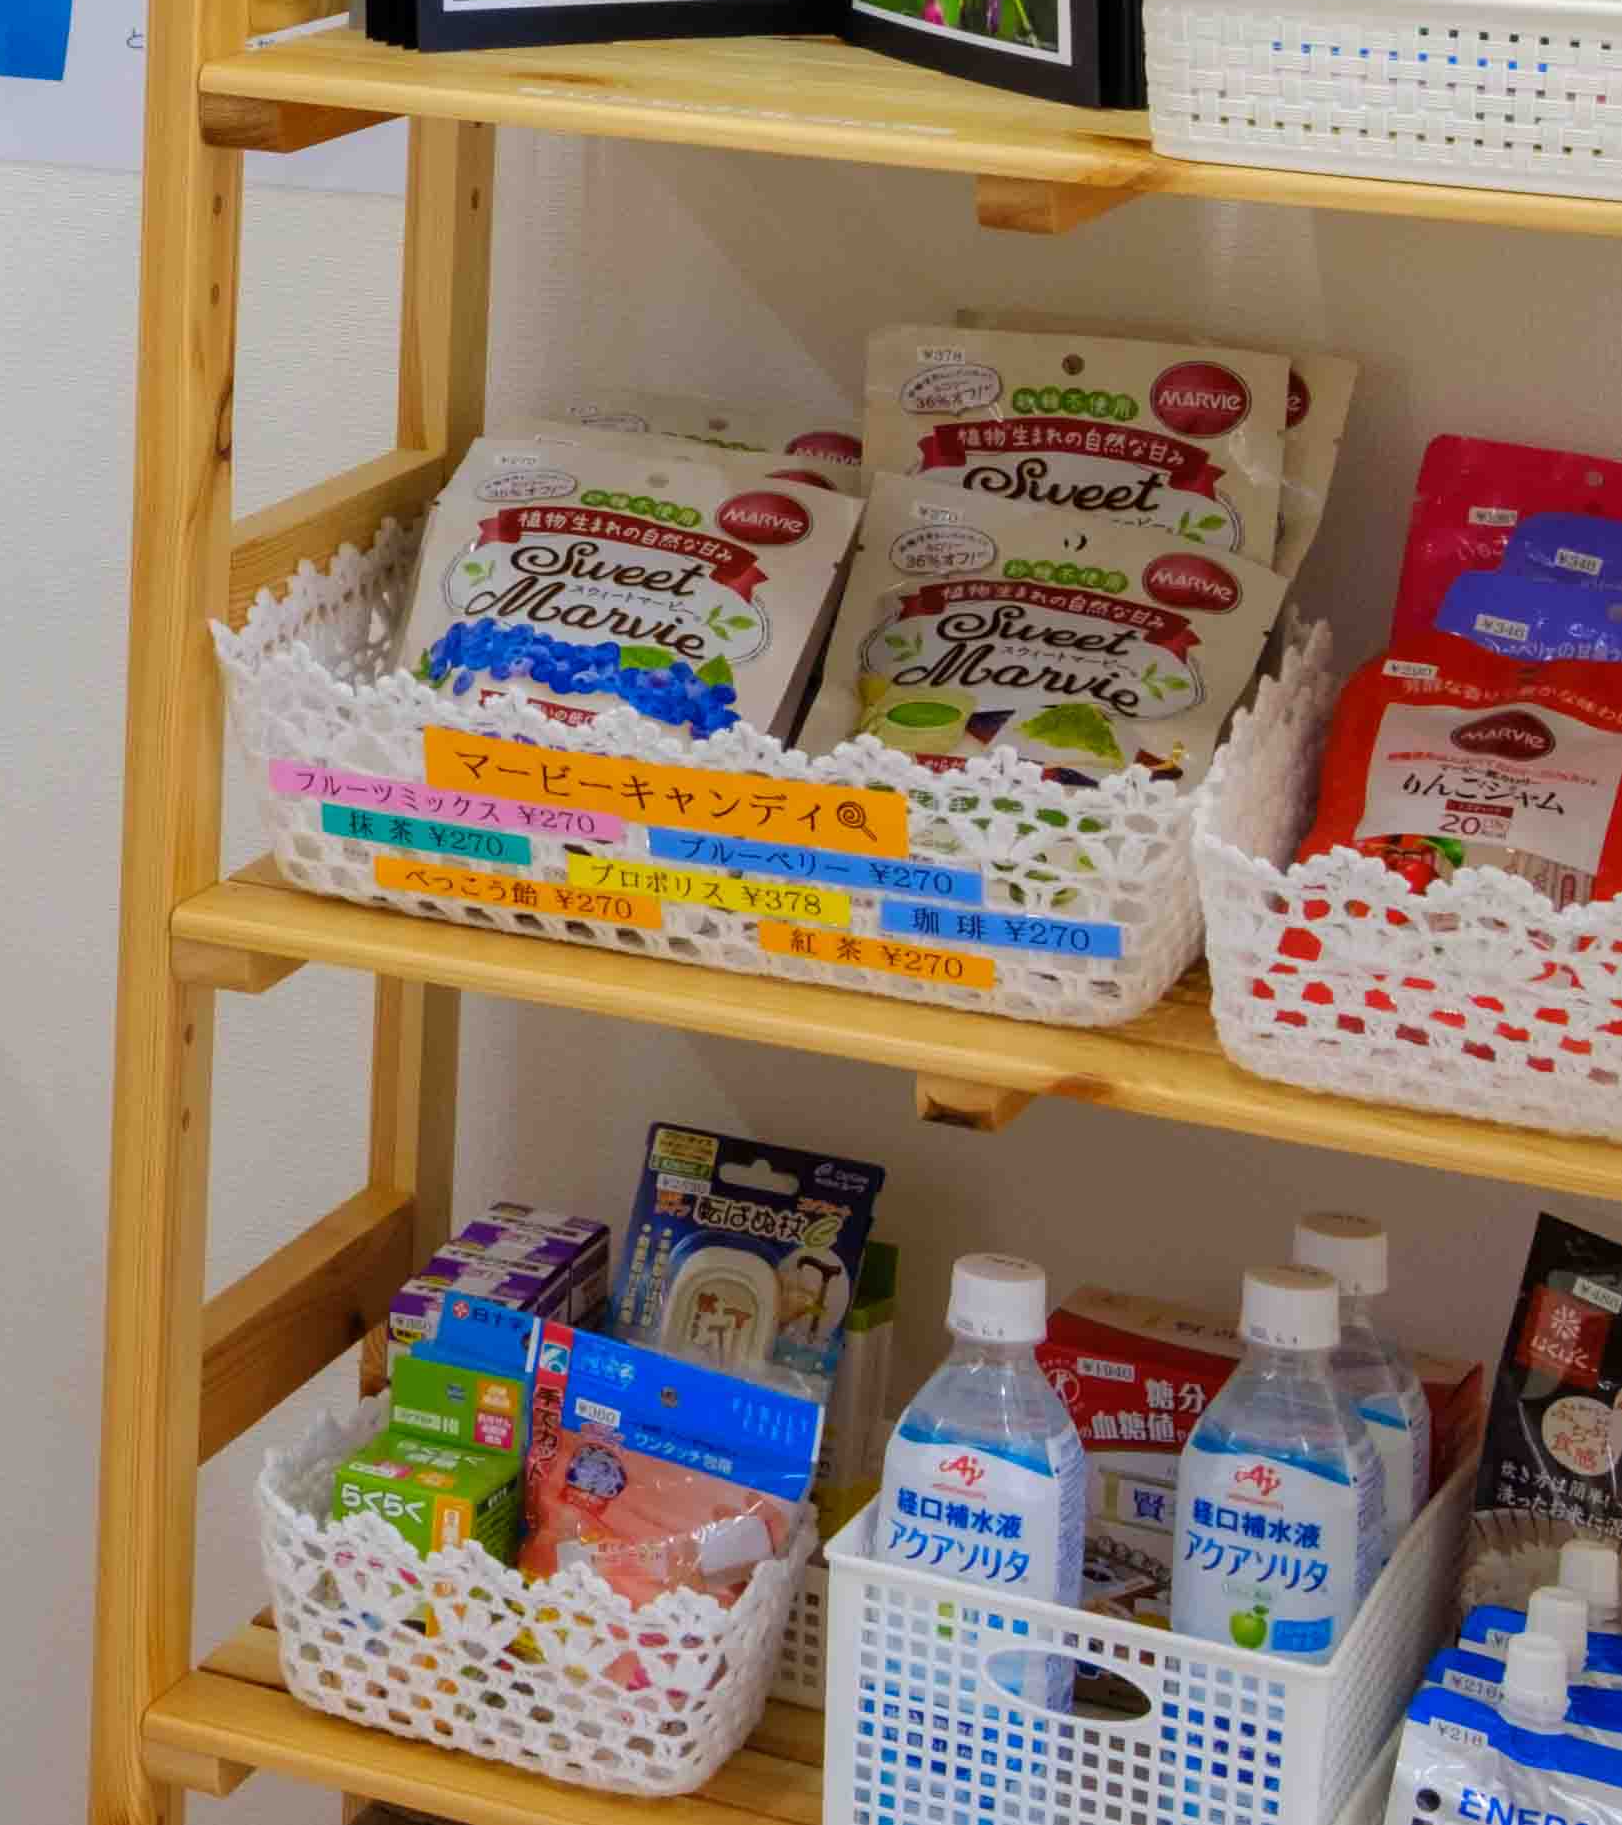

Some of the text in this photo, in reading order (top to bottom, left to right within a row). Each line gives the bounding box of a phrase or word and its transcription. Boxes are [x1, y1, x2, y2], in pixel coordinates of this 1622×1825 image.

[1157, 388, 1243, 413] MARVIE
[962, 457, 1164, 513] Sweet
[722, 510, 806, 538] MARVIE
[509, 541, 712, 597] Sweet
[1150, 569, 1233, 603] MARVIE
[464, 575, 709, 661] Marvie
[936, 605, 1137, 659] Sweet
[892, 644, 1140, 719] Marvie
[1460, 730, 1547, 750] MARVIE
[293, 768, 596, 837] フルーツミックス ¥270
[459, 748, 823, 833] マービーキャンディ
[1401, 773, 1565, 815] りんごジャム
[427, 819, 505, 853] ¥270
[1438, 803, 1481, 835] 20
[688, 833, 955, 892] ブルーベリー ¥270
[408, 864, 636, 928] べっこう飴 ¥270
[601, 858, 823, 924] プロポリス ¥378
[1003, 917, 1092, 954] ¥270
[879, 945, 965, 983] ¥270
[1145, 1378, 1207, 1414] 糖分
[339, 1483, 425, 1517] らくらく
[896, 1488, 1023, 1541] 経口補水液
[1191, 1498, 1323, 1552] 経口補水液
[887, 1519, 1032, 1584] アクアソリタ
[1183, 1531, 1331, 1594] アクアソリタ
